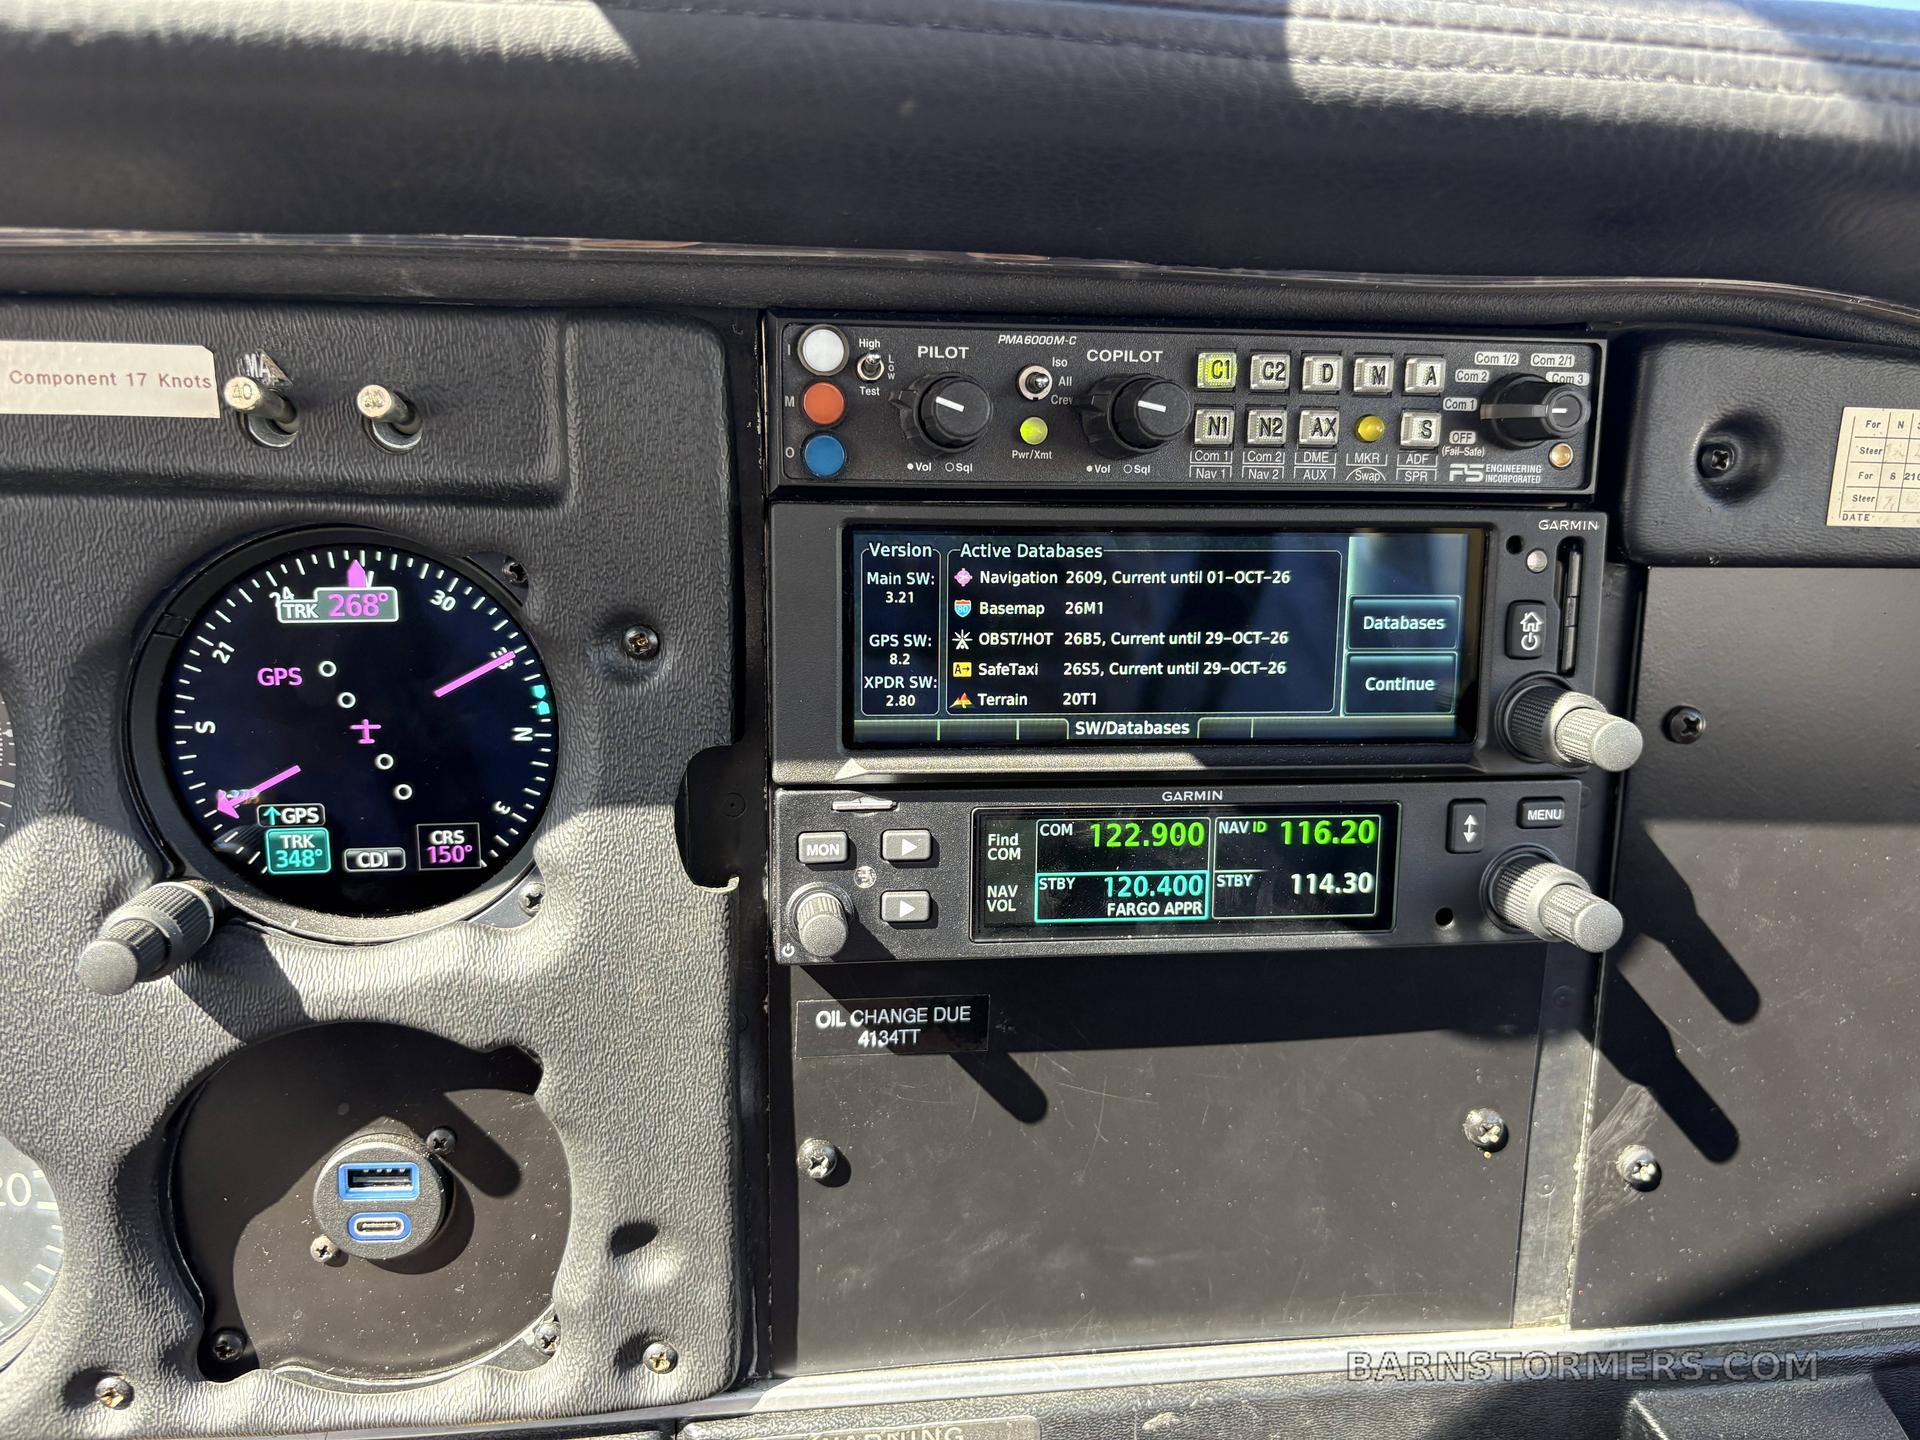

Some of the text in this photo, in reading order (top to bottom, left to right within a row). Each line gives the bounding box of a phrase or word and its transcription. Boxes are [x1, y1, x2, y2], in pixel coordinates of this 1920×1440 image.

[858, 338, 881, 350] High
[998, 335, 1077, 346] PMA6000M-C
[917, 346, 970, 359] PILOT
[1086, 350, 1163, 363] COPILOT
[1475, 353, 1518, 365] Com 1/2
[1052, 357, 1068, 368] Iso
[1532, 355, 1574, 366] Com 2/1
[1212, 359, 1231, 380] C1
[1262, 361, 1286, 381] C2
[1322, 364, 1334, 383] D
[1372, 365, 1386, 386] M
[1424, 366, 1437, 385] A
[1456, 371, 1488, 382] Com 2
[9, 370, 212, 389] Component 17 Knots
[1058, 376, 1073, 387] All
[1551, 373, 1584, 384] Com 3
[859, 387, 880, 396] Test
[784, 396, 795, 407] M
[1444, 398, 1475, 410] Com 1
[1208, 416, 1227, 436] N1
[1259, 417, 1283, 437] N2
[1311, 417, 1337, 437] AX
[1420, 420, 1433, 440] S
[1865, 420, 1905, 429] For N
[1452, 432, 1472, 443] OFF
[1011, 450, 1053, 460] Pwr/Xmt
[1195, 451, 1228, 462] Com 1
[1247, 451, 1282, 463] Com 2
[1303, 452, 1329, 463] DME
[1859, 447, 1883, 455] Steer
[1354, 453, 1380, 464] MKR
[1406, 454, 1429, 464] ADF
[915, 462, 973, 474] Vol Sql
[1094, 465, 1151, 476] Vol Sql
[1196, 468, 1226, 479] Nav 1
[1248, 469, 1280, 480] Nav 2
[1303, 469, 1327, 480] AUX
[1485, 464, 1542, 474] ENGINEERING
[1354, 471, 1381, 483] Swap
[1404, 472, 1428, 482] SPR
[1485, 474, 1541, 484] INCORPORATED
[1858, 471, 1873, 480] For
[1889, 472, 1896, 480] S
[1852, 494, 1875, 502] Steer
[1538, 519, 1599, 531] GARMIN
[868, 542, 933, 558] Version
[960, 543, 1103, 558] Active Databases
[866, 572, 935, 586] Main SW:
[979, 570, 1291, 587] Navigation 2609, Current until 01-OCT-26
[430, 589, 457, 612] 30
[885, 591, 914, 603] 3.21
[283, 604, 319, 618] TRK
[328, 592, 389, 617] 268°
[979, 602, 1104, 618] Basemap 26M1
[1363, 615, 1446, 630] Databases
[869, 634, 932, 648] GPS SW:
[978, 631, 1289, 647] OBST/HOT 26B5, Current until 29-OCT-26
[212, 641, 235, 664] 21
[889, 654, 911, 665] 8.2
[978, 661, 1287, 677] SafeTaxi 26S5, Current until 29-OCT-26
[257, 667, 303, 687] GPS
[864, 676, 938, 689] XPDR SW:
[1365, 676, 1435, 691] Continue
[885, 695, 916, 707] 2.80
[977, 692, 1097, 706] Terrain 20T1
[195, 720, 217, 734] S
[513, 726, 534, 742] N
[1075, 720, 1190, 736] SW/Databases
[1161, 790, 1223, 802] GARMIN
[492, 800, 511, 815] 3
[1527, 809, 1562, 820] MENU
[281, 807, 320, 824] GPS
[431, 830, 465, 844] CRS
[1039, 821, 1205, 847] COM 122.900
[1218, 819, 1377, 845] NAV ID 116.20
[280, 833, 314, 848] TRK
[988, 833, 1019, 847] Find
[426, 844, 473, 863] 150°
[806, 844, 840, 857] MON
[987, 847, 1021, 861] COM
[275, 848, 323, 868] 348°
[356, 851, 389, 868] CDI
[1039, 875, 1204, 898] STBY 120.400
[1216, 872, 1375, 895] STBY 114.30
[987, 885, 1018, 898] NAV
[987, 899, 1017, 912] VOL
[1107, 901, 1203, 917] FARGO APPR
[815, 1006, 971, 1029] OIL CHANGE DUE
[857, 1028, 921, 1048] 4134TT
[0, 1172, 31, 1207] 0
